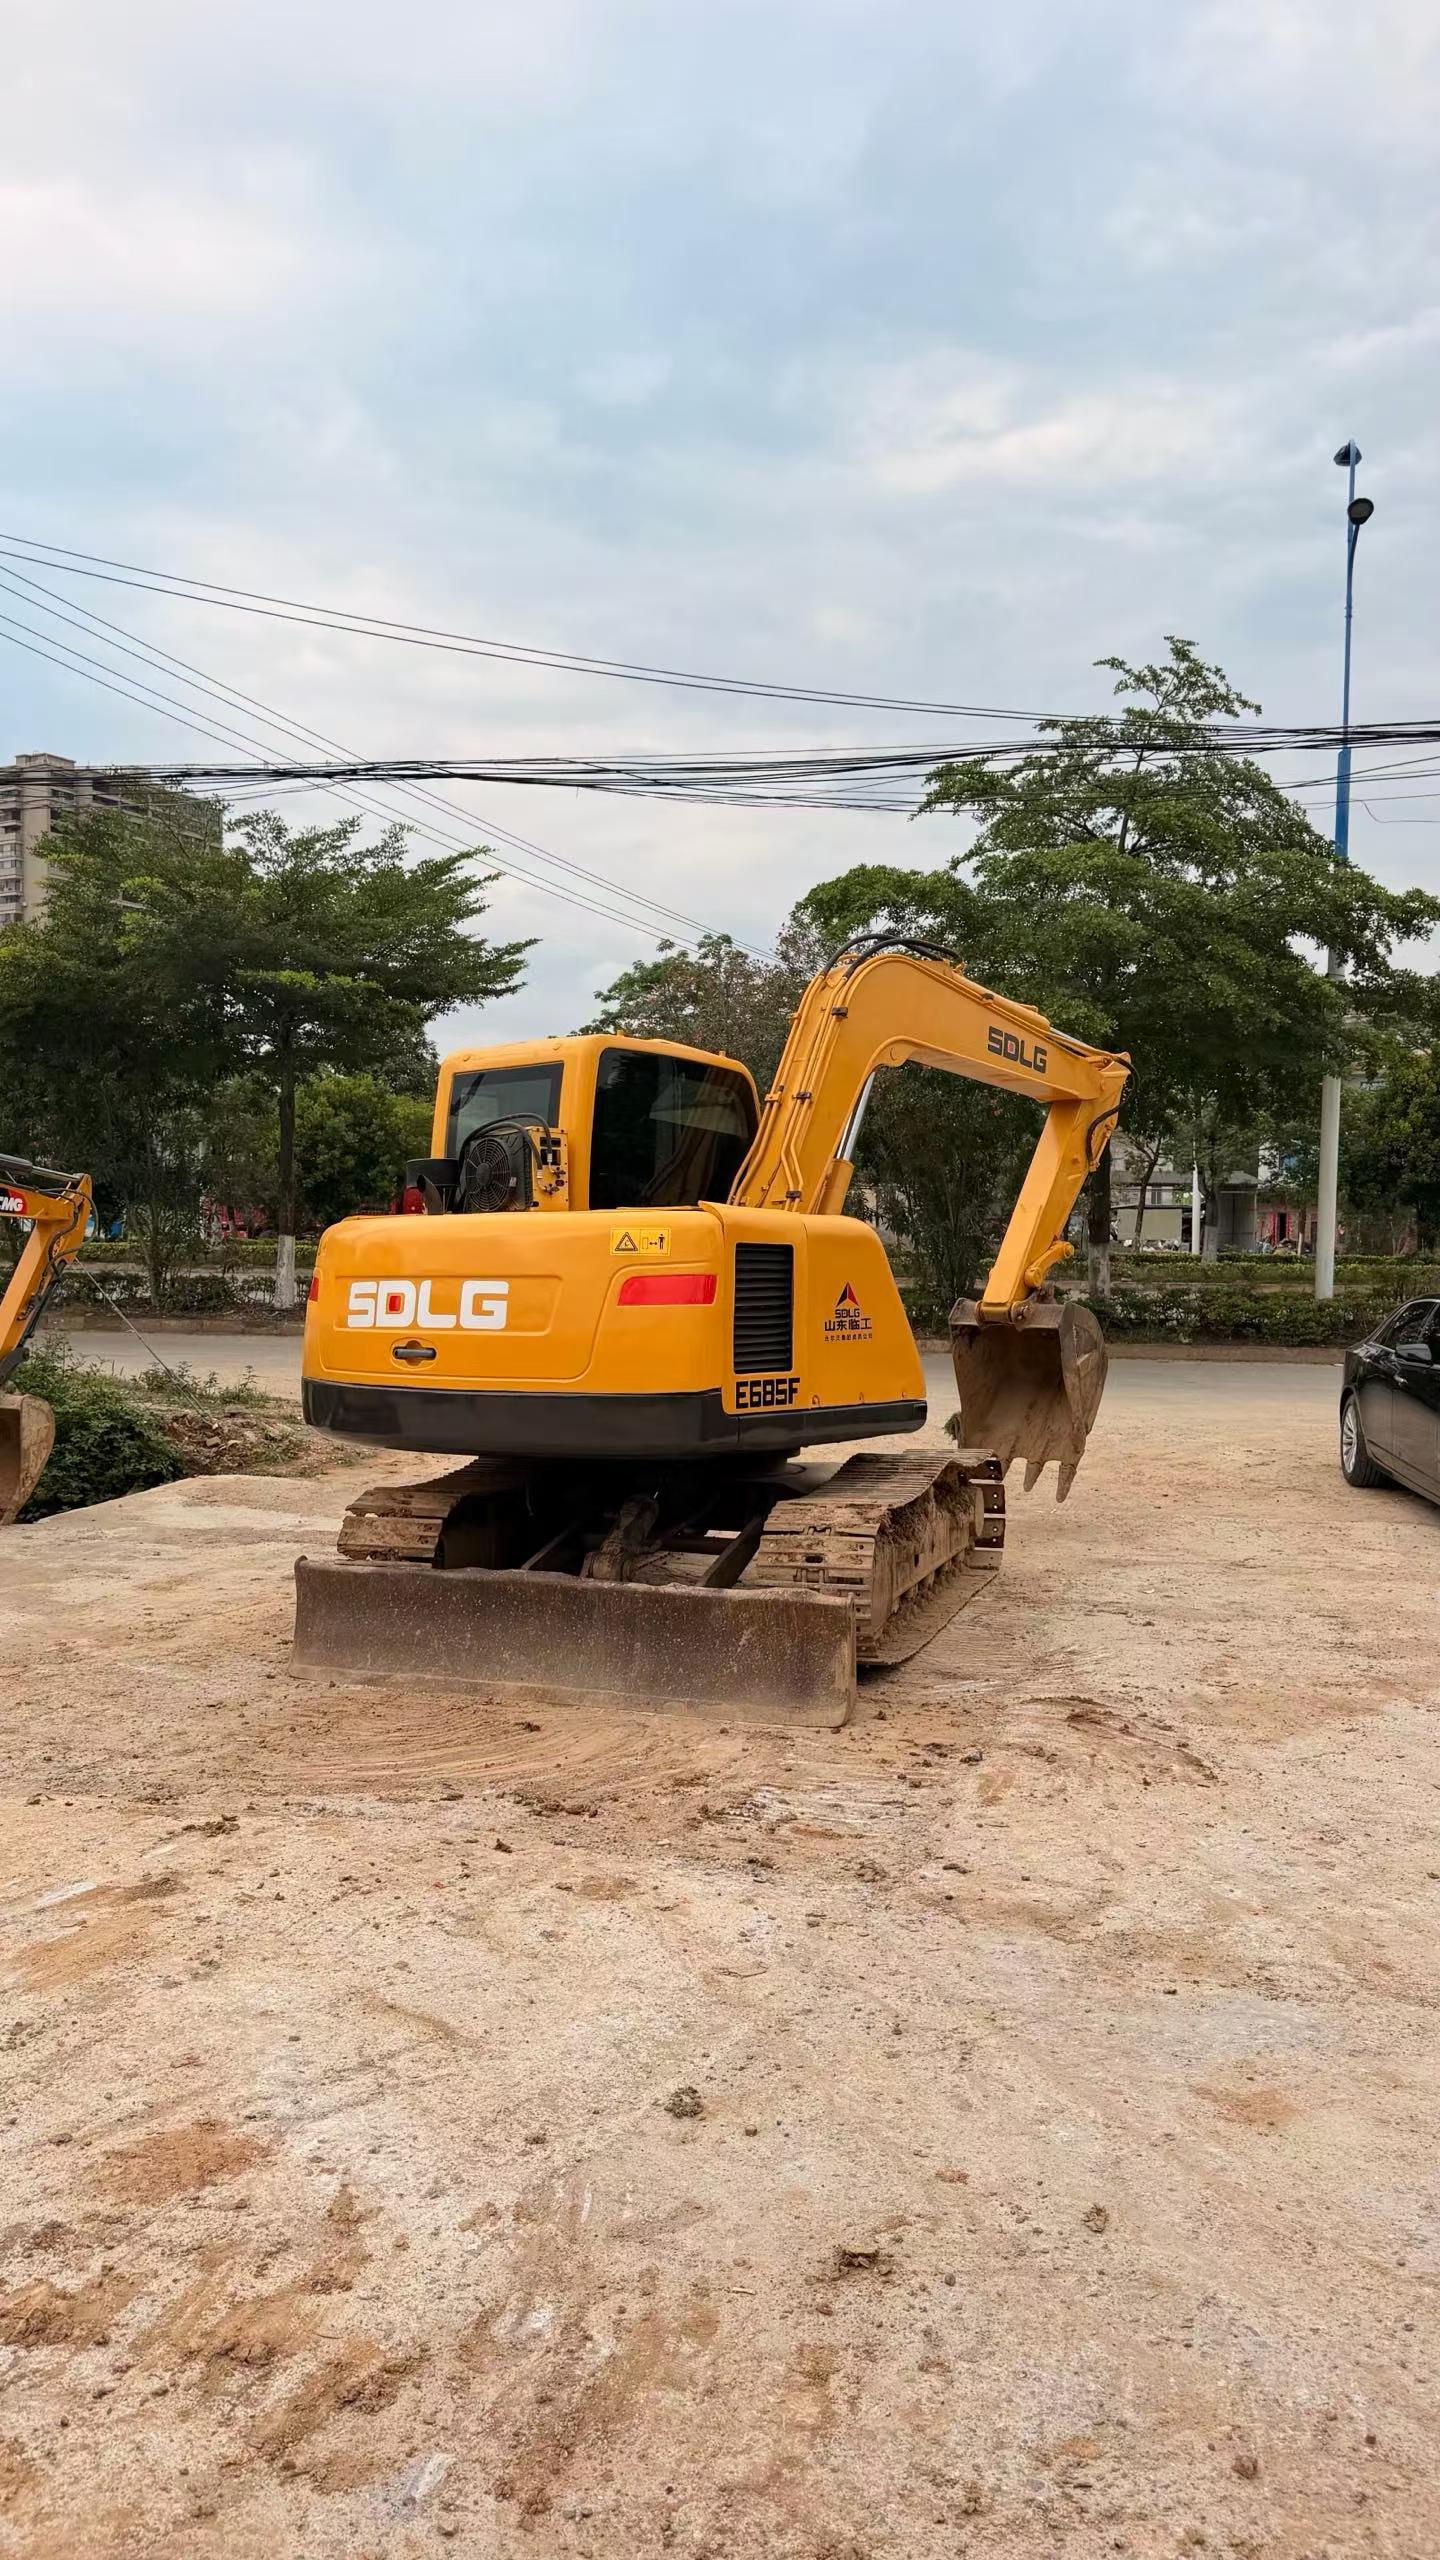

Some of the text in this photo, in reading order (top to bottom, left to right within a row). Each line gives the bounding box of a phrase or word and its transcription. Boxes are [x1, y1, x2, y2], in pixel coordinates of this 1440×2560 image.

[988, 1026, 1047, 1073] SDLG
[348, 1280, 509, 1329] SDLG
[835, 1309, 860, 1318] SDLG
[824, 1318, 872, 1331] 山东临工
[736, 1378, 800, 1409] E685F
